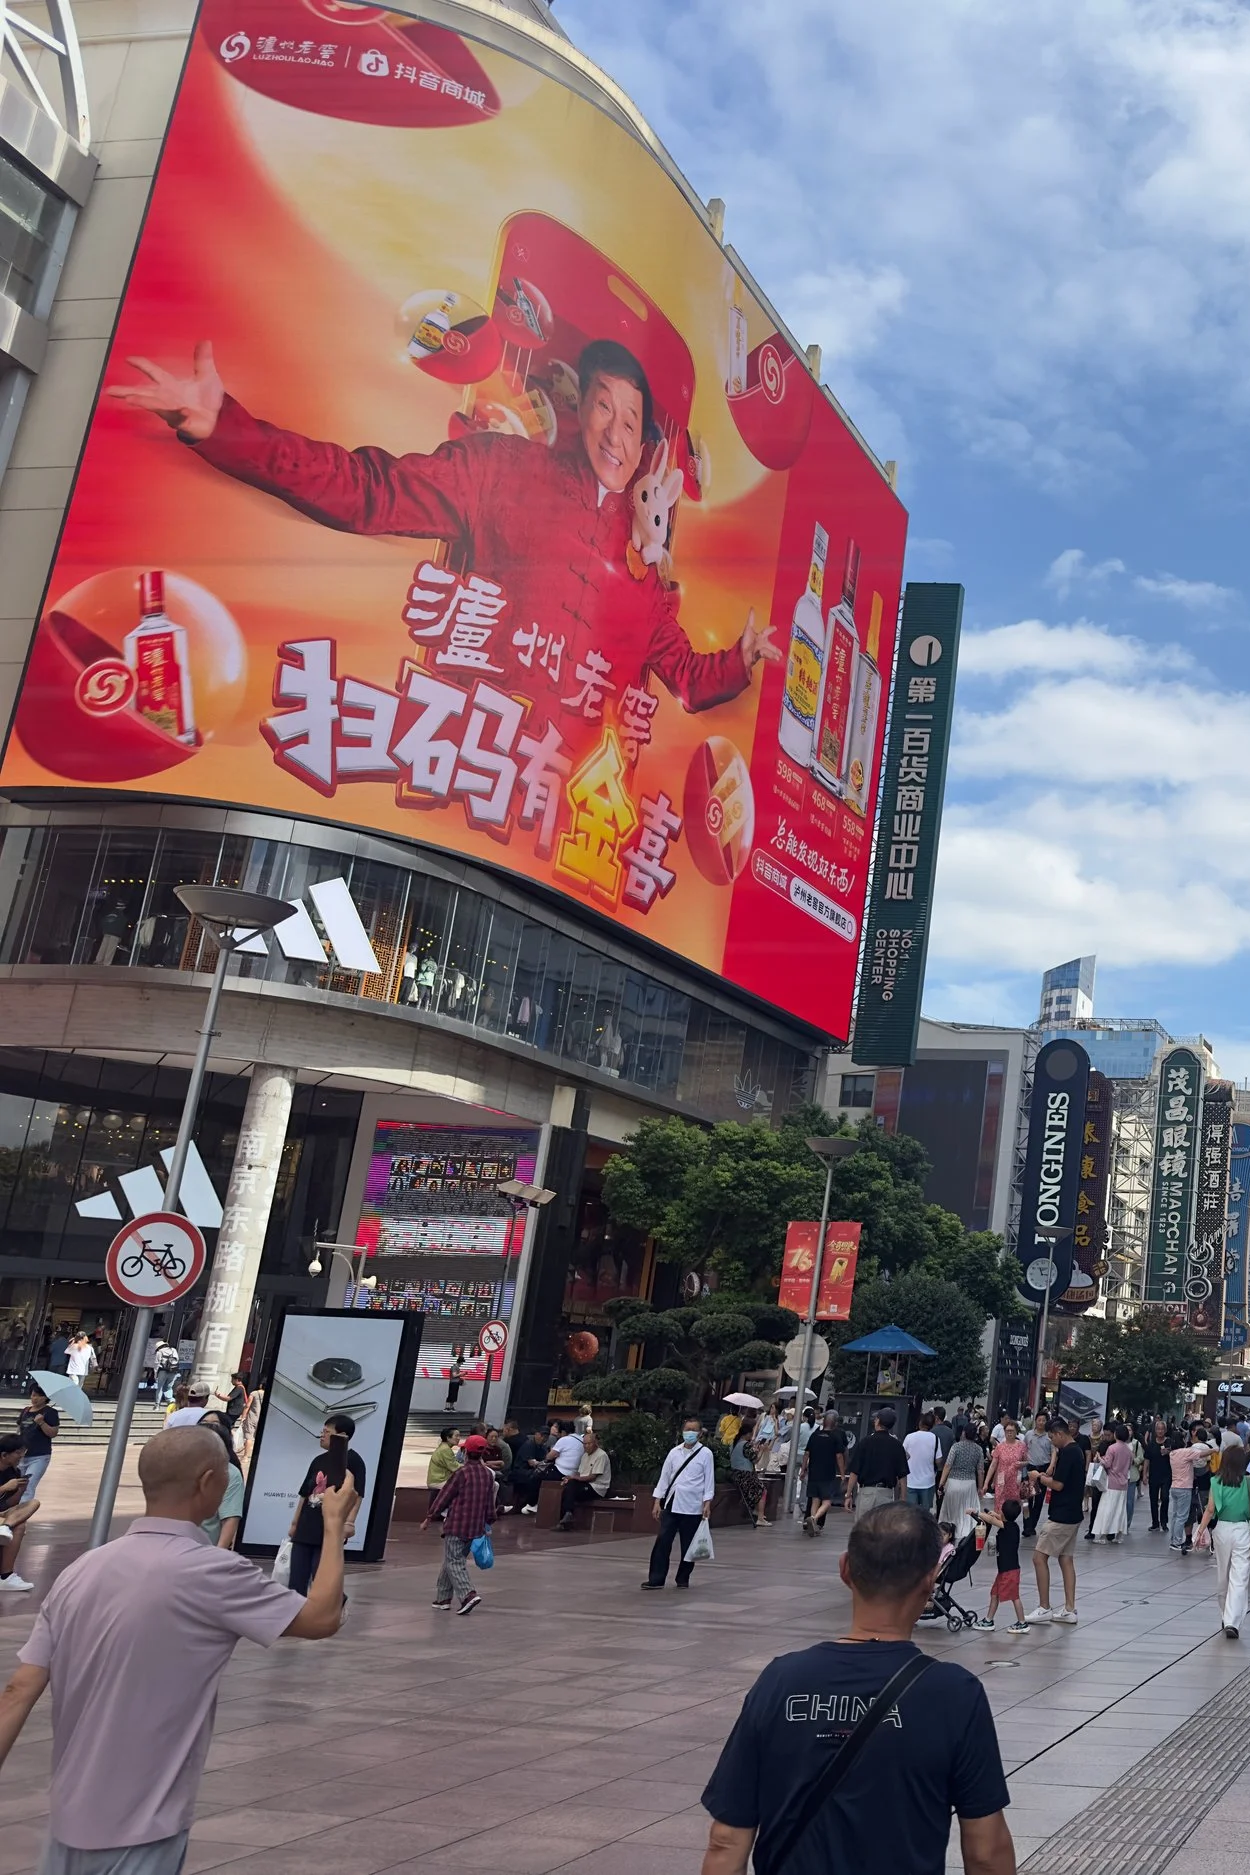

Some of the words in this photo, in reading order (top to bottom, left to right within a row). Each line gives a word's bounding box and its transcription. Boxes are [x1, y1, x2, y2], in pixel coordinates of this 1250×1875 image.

[252, 53, 335, 67] LUZHOULAOJIAO
[394, 62, 486, 109] 抖音商城
[264, 638, 684, 906] 扫码有金喜
[776, 760, 793, 784] 598
[884, 676, 938, 900] 第一百货商业中心
[811, 790, 826, 811] 468
[842, 815, 856, 836] 558
[755, 857, 788, 892] 抖音商城
[793, 883, 847, 931] 泸州老窖官方旗舰店
[870, 928, 888, 985] CENTER
[882, 929, 901, 1001] SHOPPING
[1034, 1092, 1070, 1245] LONGINES
[1160, 1181, 1169, 1208] SINCE
[192, 1129, 268, 1386] 南京东路捌佰号
[788, 1247, 813, 1272] 76
[1010, 1334, 1029, 1347] LONGINES
[786, 1694, 903, 1729] CHINA
